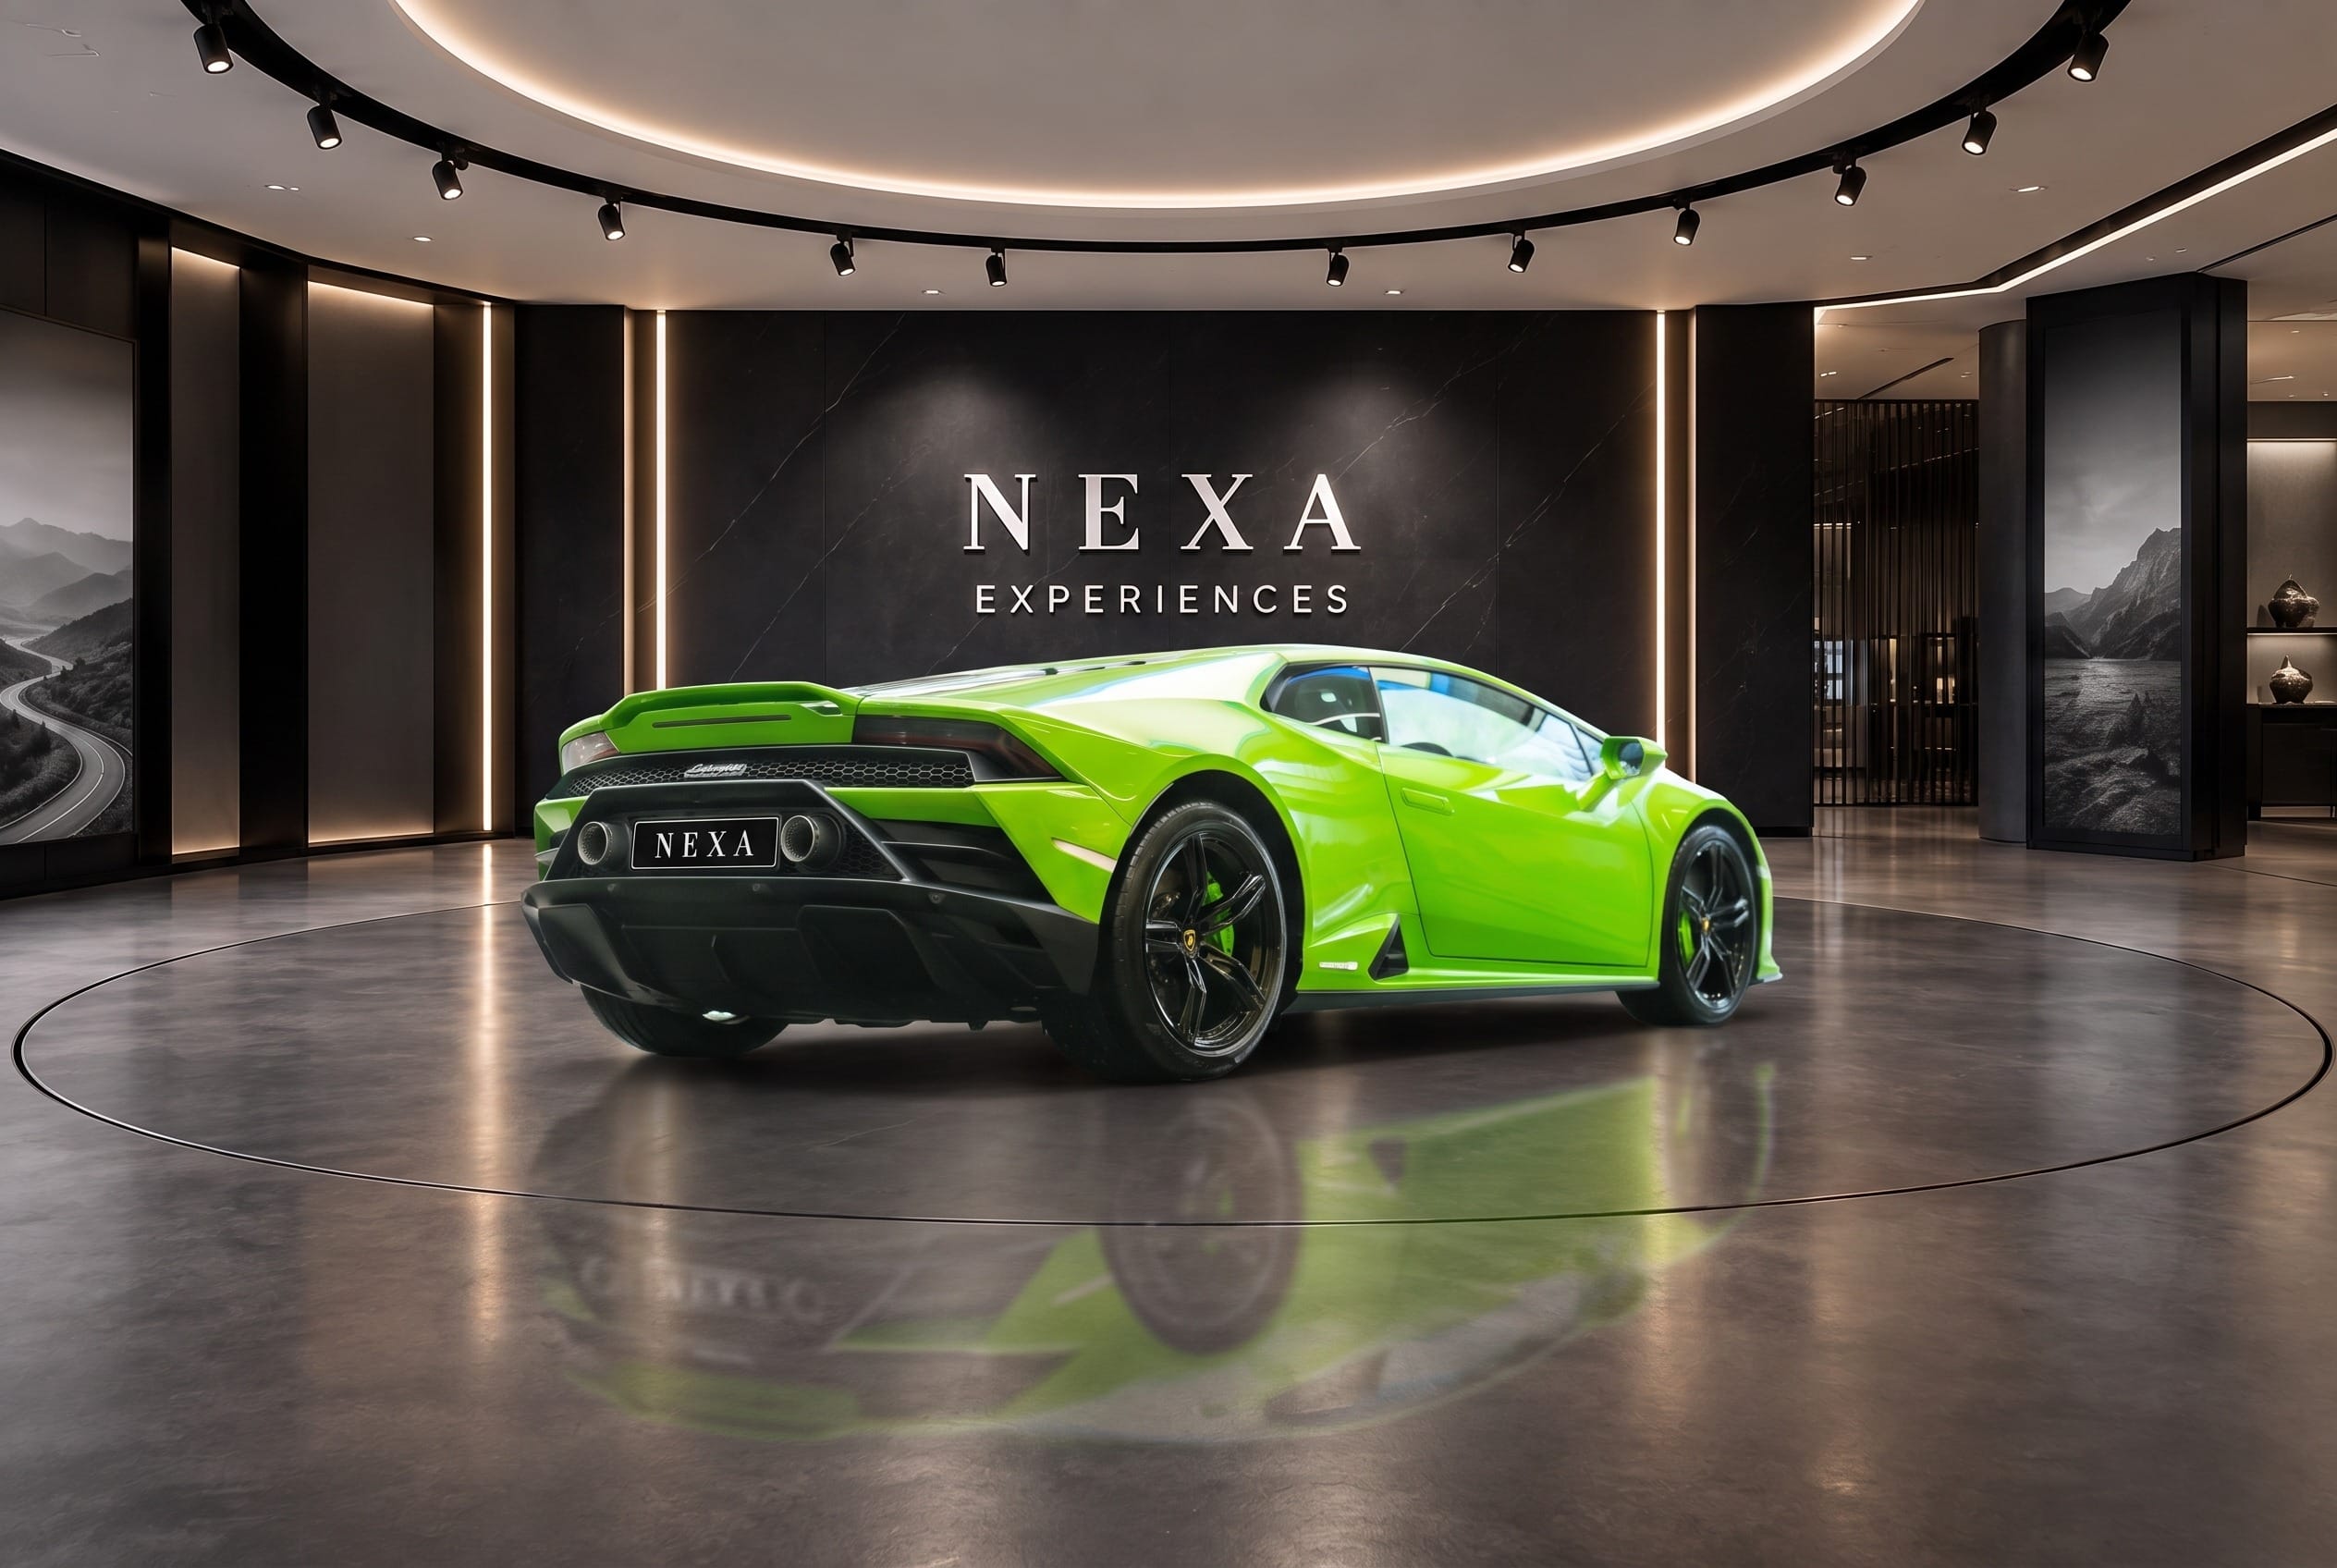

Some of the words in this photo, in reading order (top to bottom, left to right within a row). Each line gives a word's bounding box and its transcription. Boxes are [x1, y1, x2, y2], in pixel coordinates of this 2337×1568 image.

[963, 473, 1362, 551] NEXA
[976, 584, 1348, 614] EXPERIENCES
[655, 829, 754, 859] NEXA
